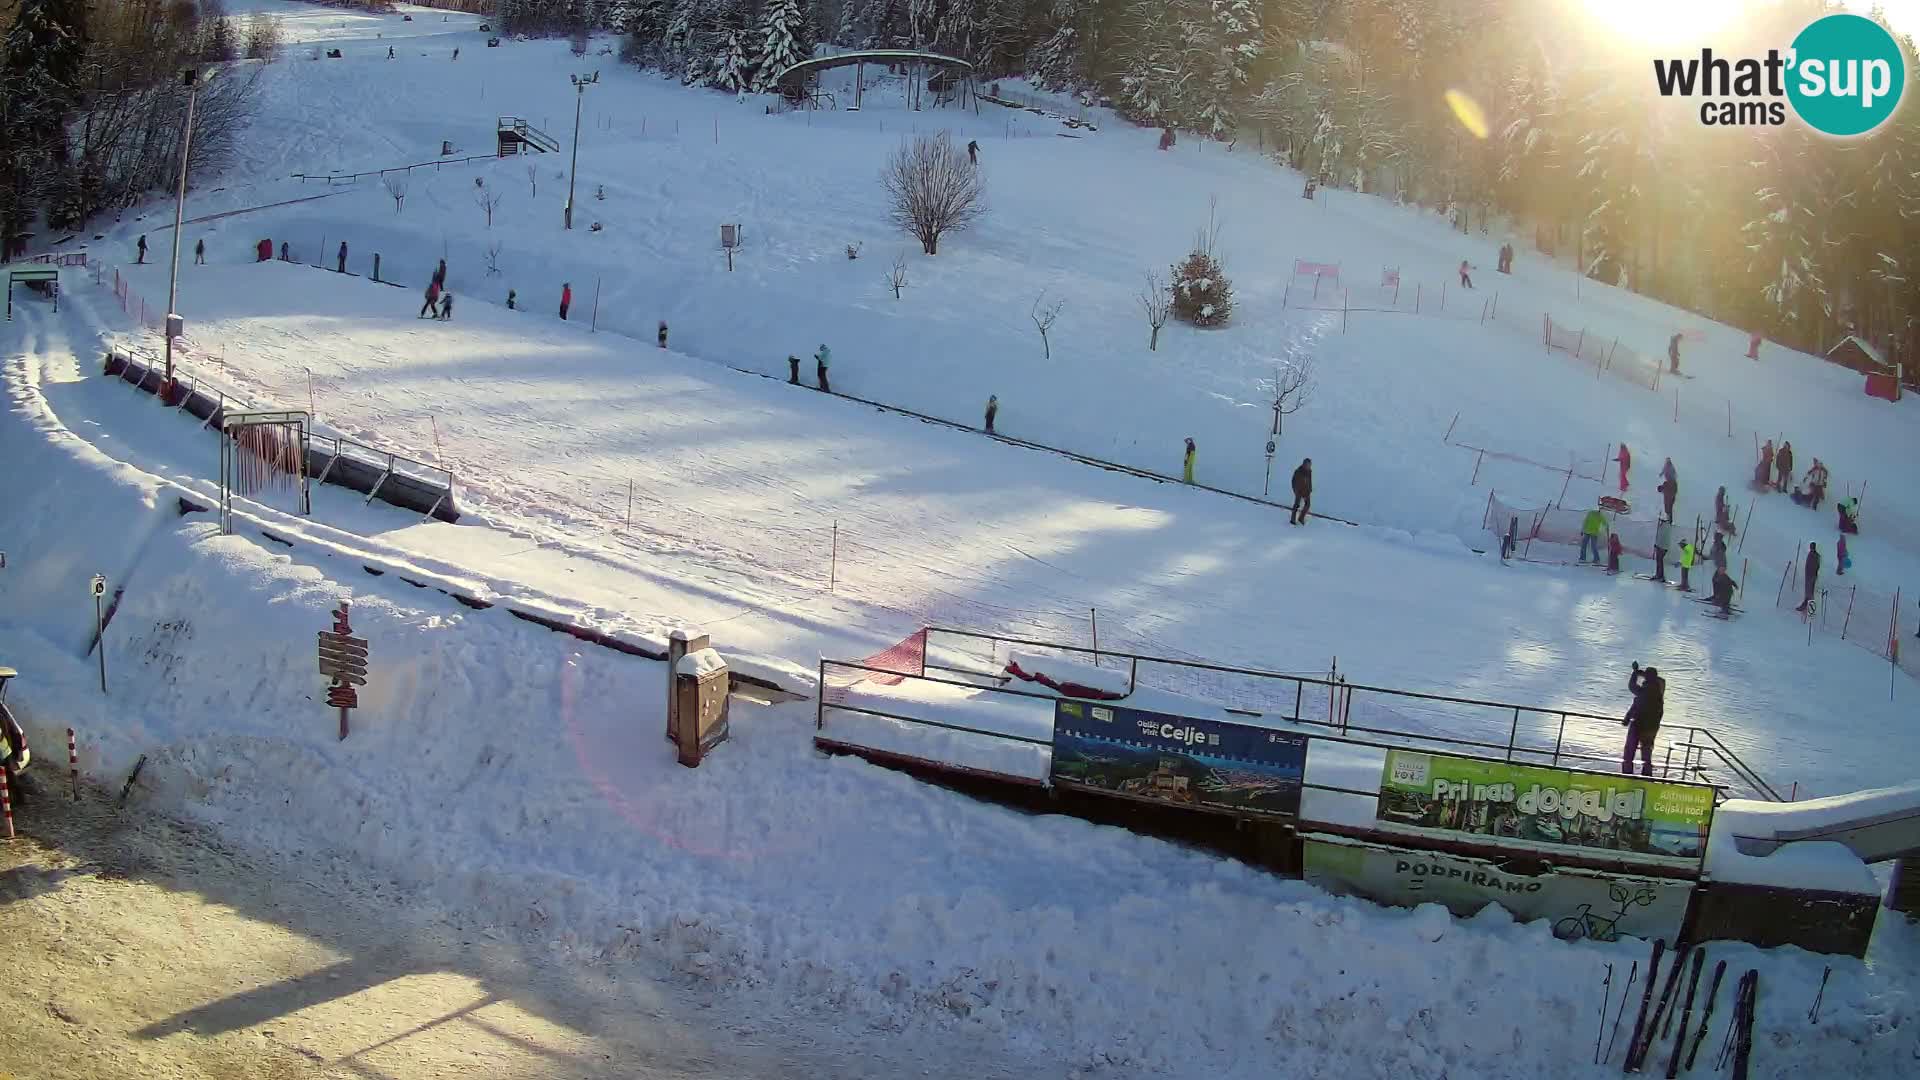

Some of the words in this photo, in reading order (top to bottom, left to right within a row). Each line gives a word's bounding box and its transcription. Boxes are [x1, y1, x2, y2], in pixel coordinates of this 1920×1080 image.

[1160, 723, 1206, 746] Celje
[1432, 778, 1469, 801] Pri
[1473, 782, 1515, 803] nas
[1396, 859, 1543, 894] PODPIRAMO
